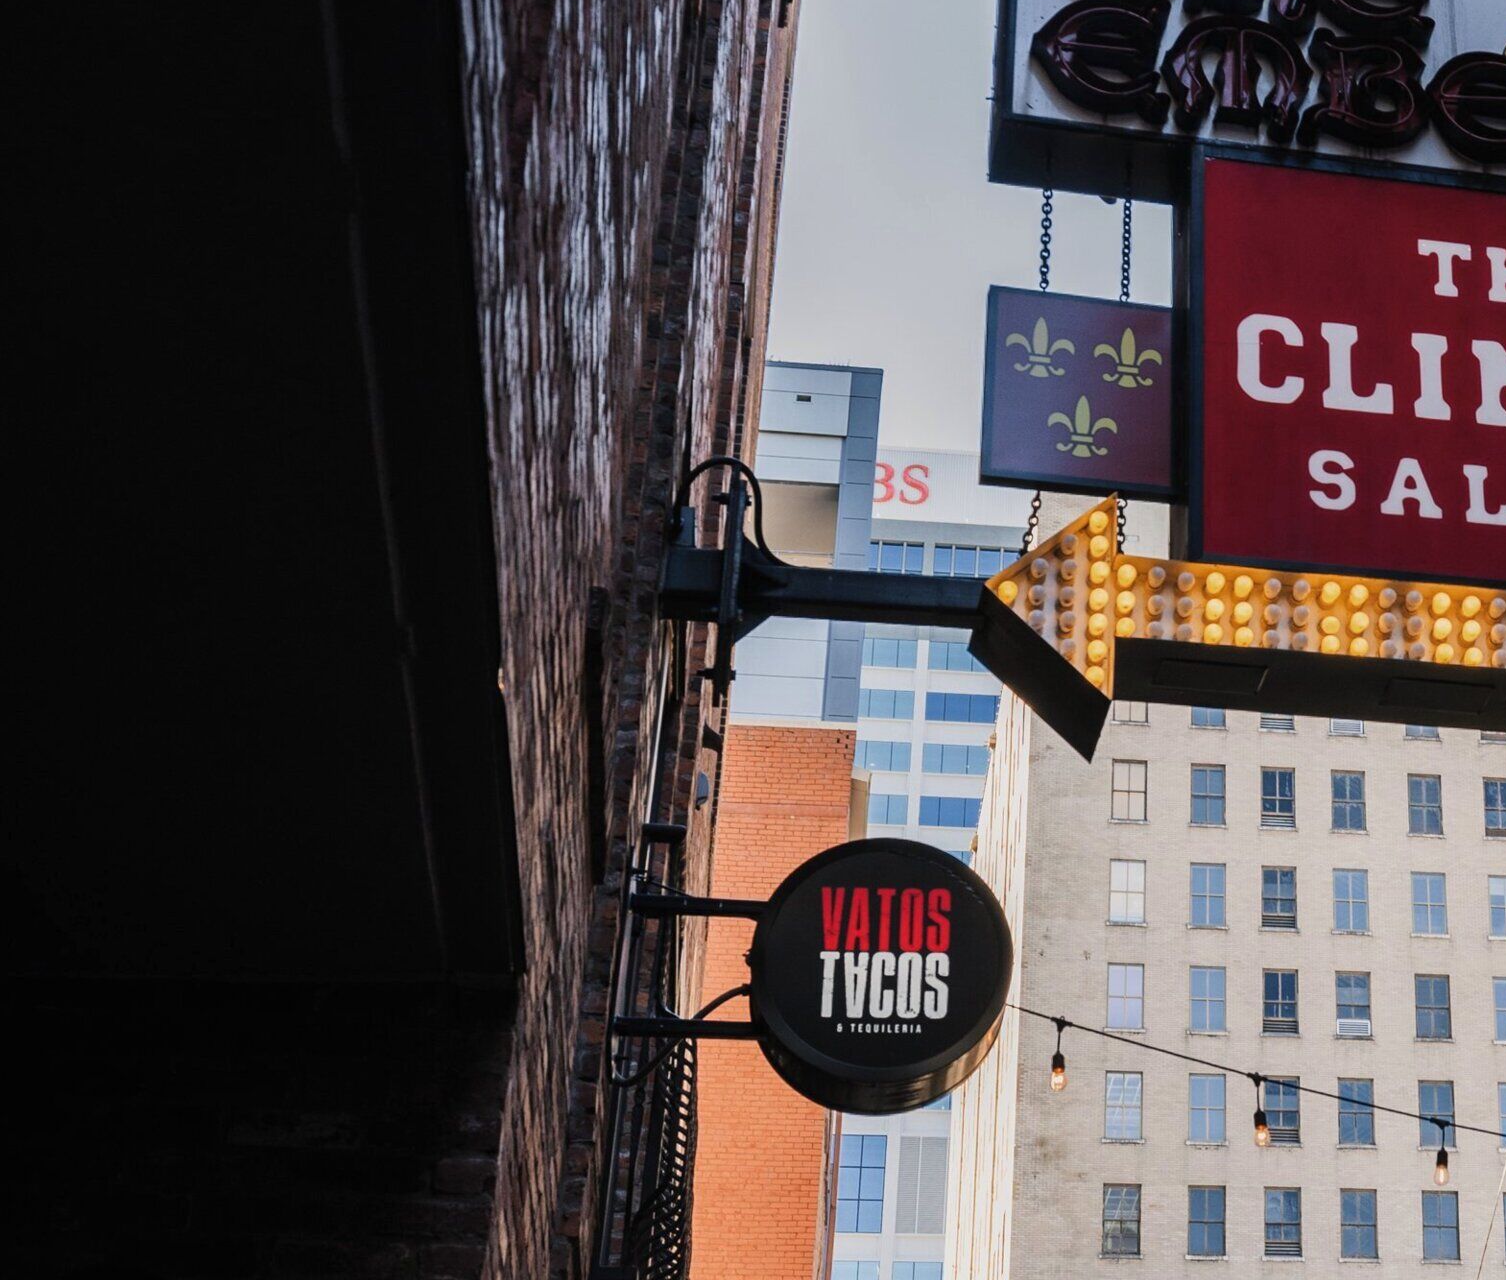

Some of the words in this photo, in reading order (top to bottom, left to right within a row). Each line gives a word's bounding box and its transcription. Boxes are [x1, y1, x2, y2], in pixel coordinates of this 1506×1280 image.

[873, 462, 930, 505] BS
[820, 886, 951, 952] VATOS
[819, 951, 950, 1019] TACOS
[849, 1023, 923, 1034] TEQUILERIA
